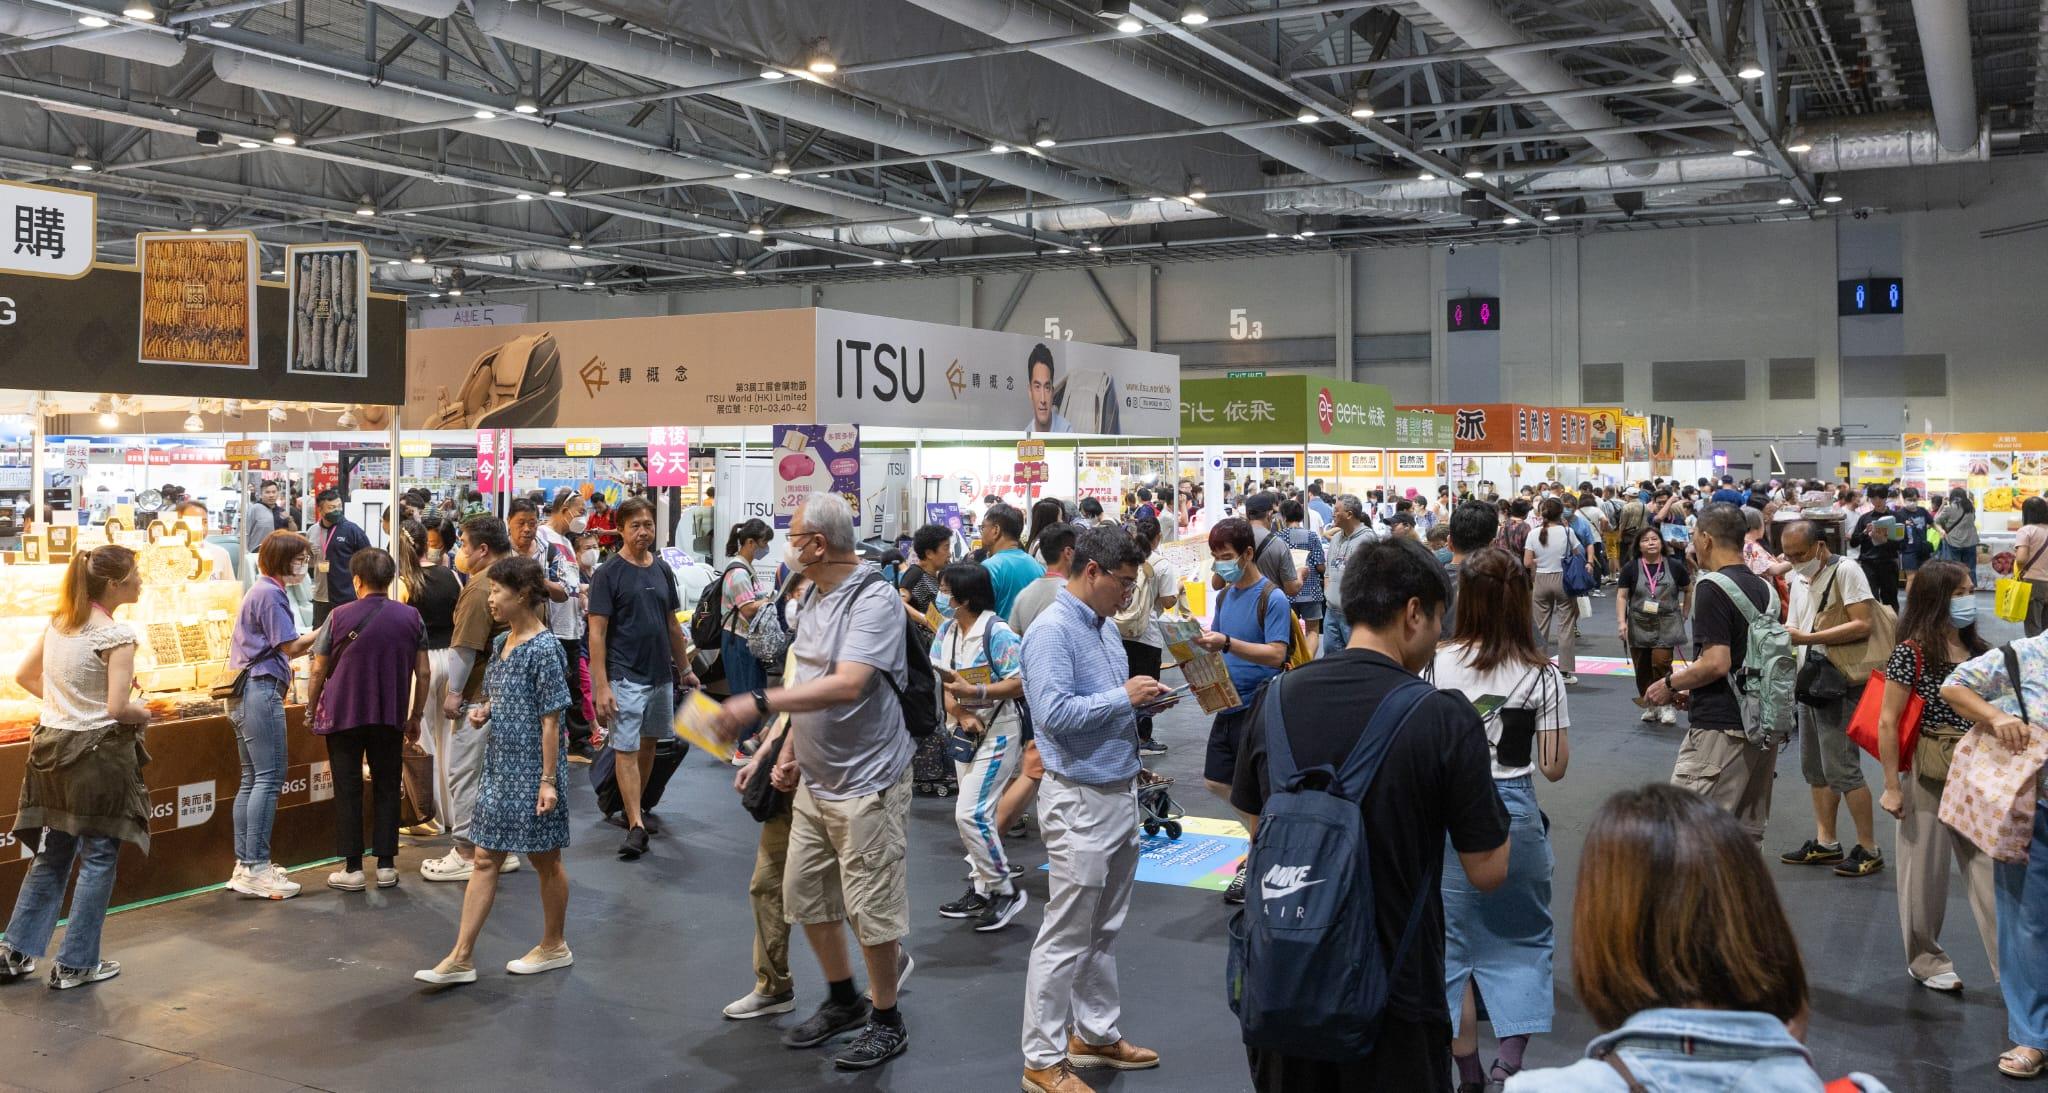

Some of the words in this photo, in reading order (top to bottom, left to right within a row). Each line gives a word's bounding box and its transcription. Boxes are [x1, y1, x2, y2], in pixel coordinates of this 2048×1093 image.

[14, 204, 65, 260] 購
[1230, 308, 1263, 341] 5.3
[836, 338, 925, 404] ITSU
[706, 394, 726, 404] ITSU
[727, 393, 752, 403] World
[754, 393, 773, 403] (HK)
[775, 392, 807, 402] Limited
[1223, 400, 1276, 422] 依飛
[1519, 407, 1552, 443] 自然派
[66, 458, 88, 470] 今天
[649, 451, 687, 475] 今天
[887, 462, 906, 476] ITSU
[1399, 455, 1424, 465] 自然派
[743, 502, 774, 517] ITSU
[281, 778, 307, 795] BGS
[1264, 863, 1312, 888] NIKE
